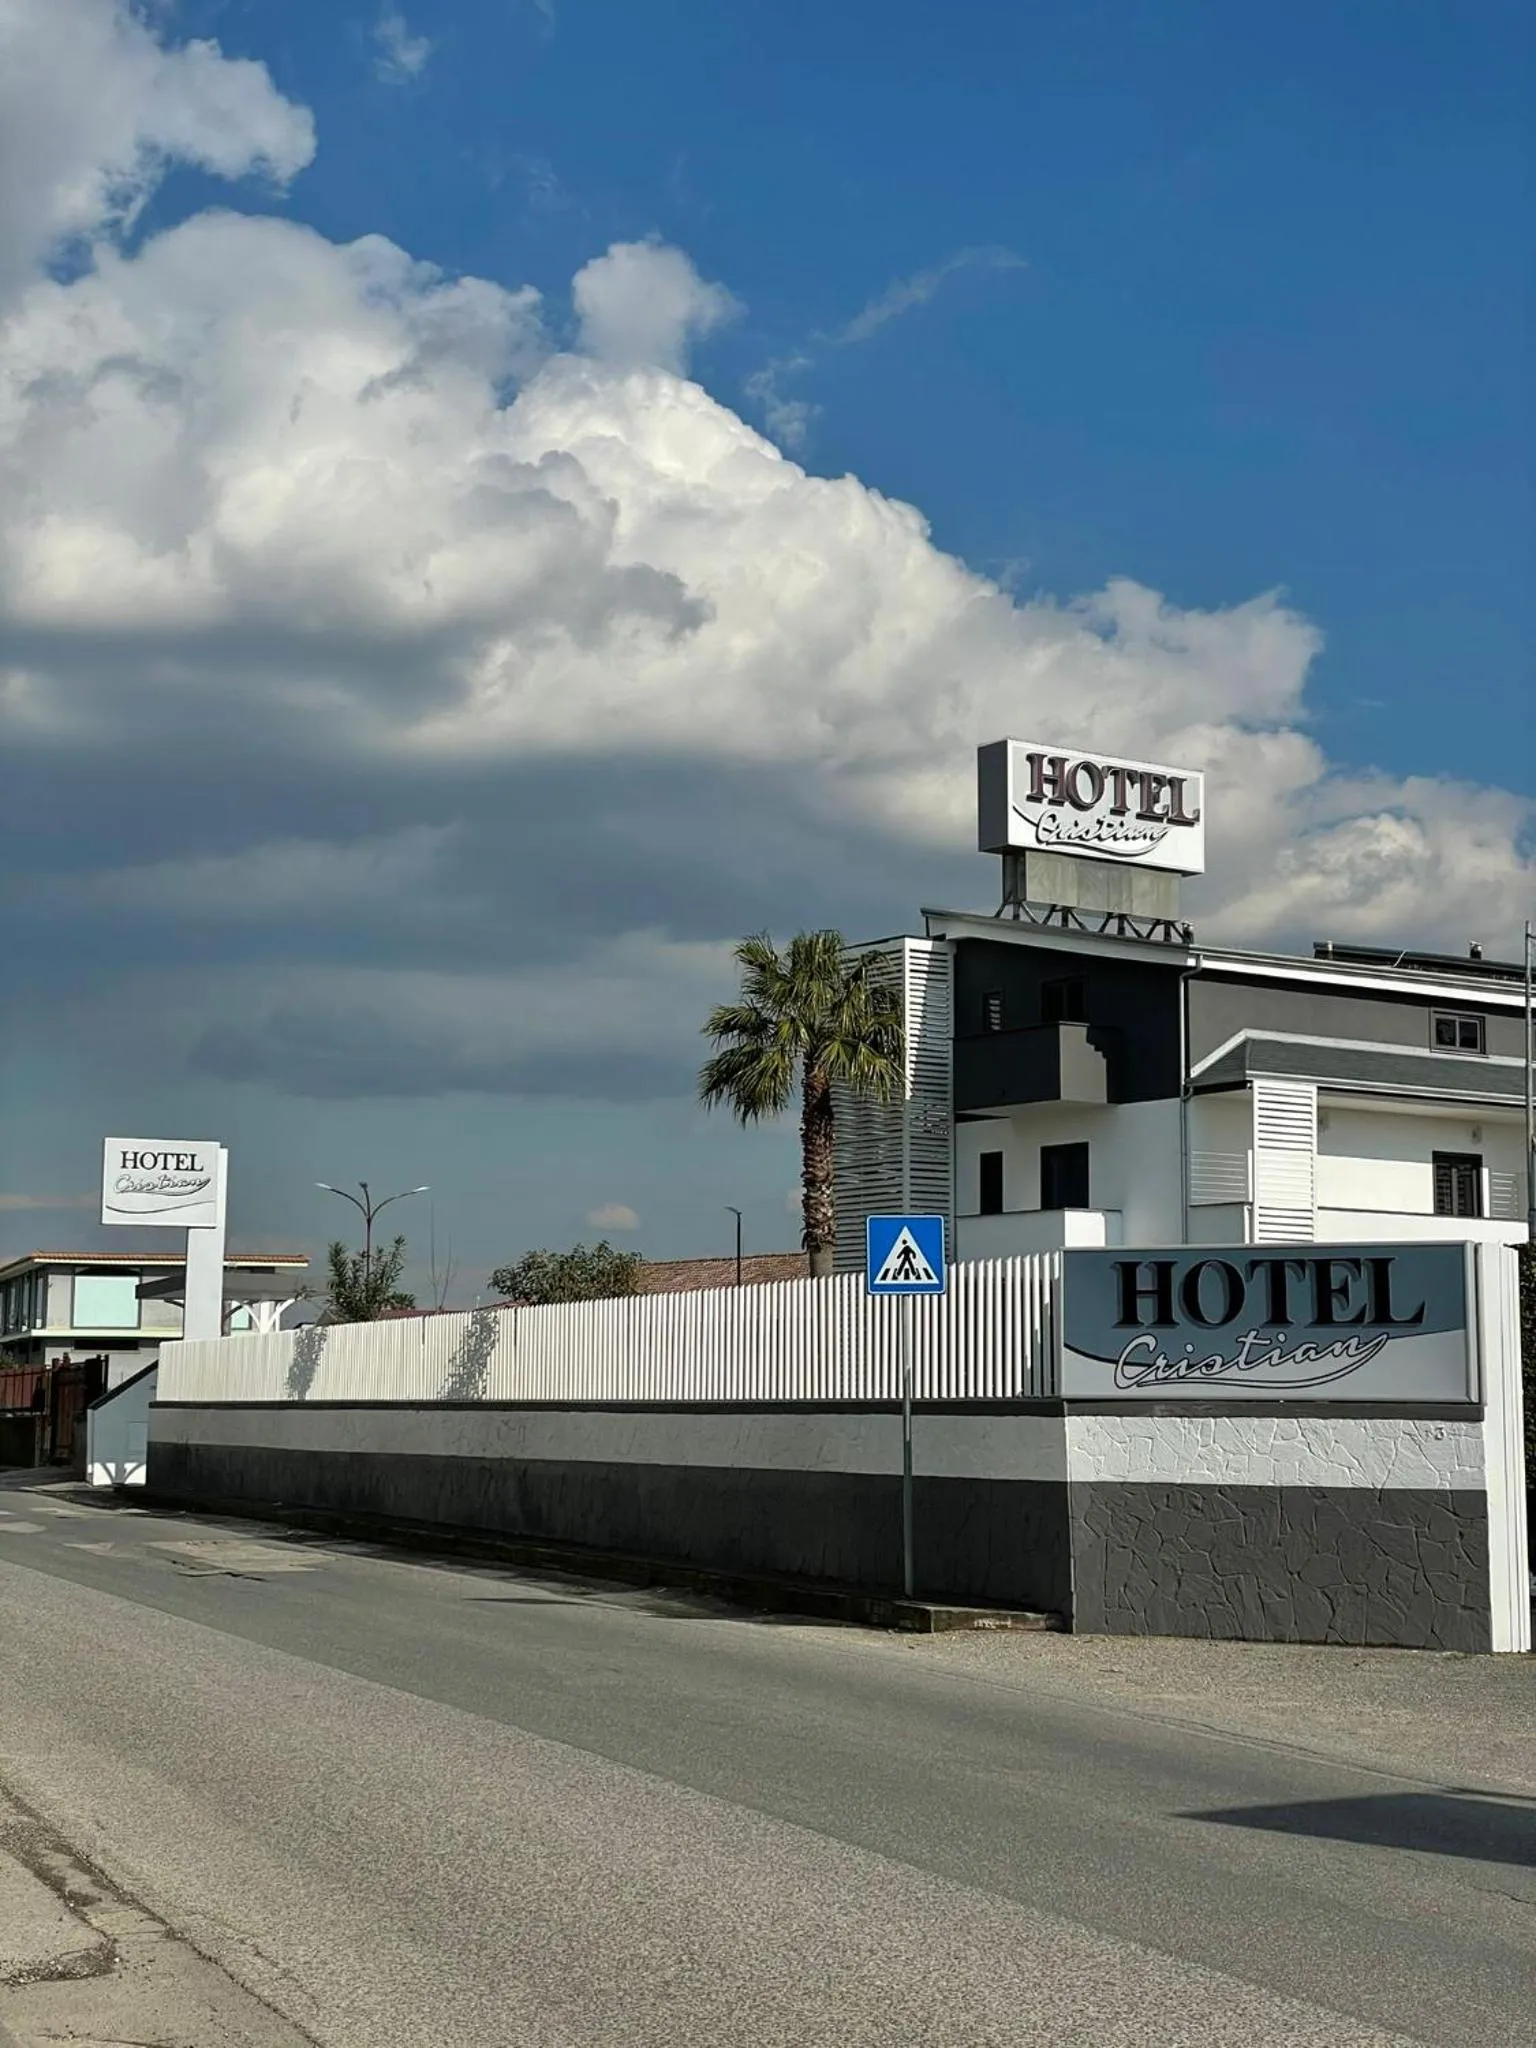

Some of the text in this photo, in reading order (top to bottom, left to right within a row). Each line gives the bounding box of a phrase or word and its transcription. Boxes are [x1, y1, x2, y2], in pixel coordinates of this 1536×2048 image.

[1026, 753, 1200, 827] HOTEL
[120, 1151, 204, 1171] HOTEL
[1111, 1257, 1426, 1329] HOTEL
[1114, 1328, 1389, 1389] Cristian
